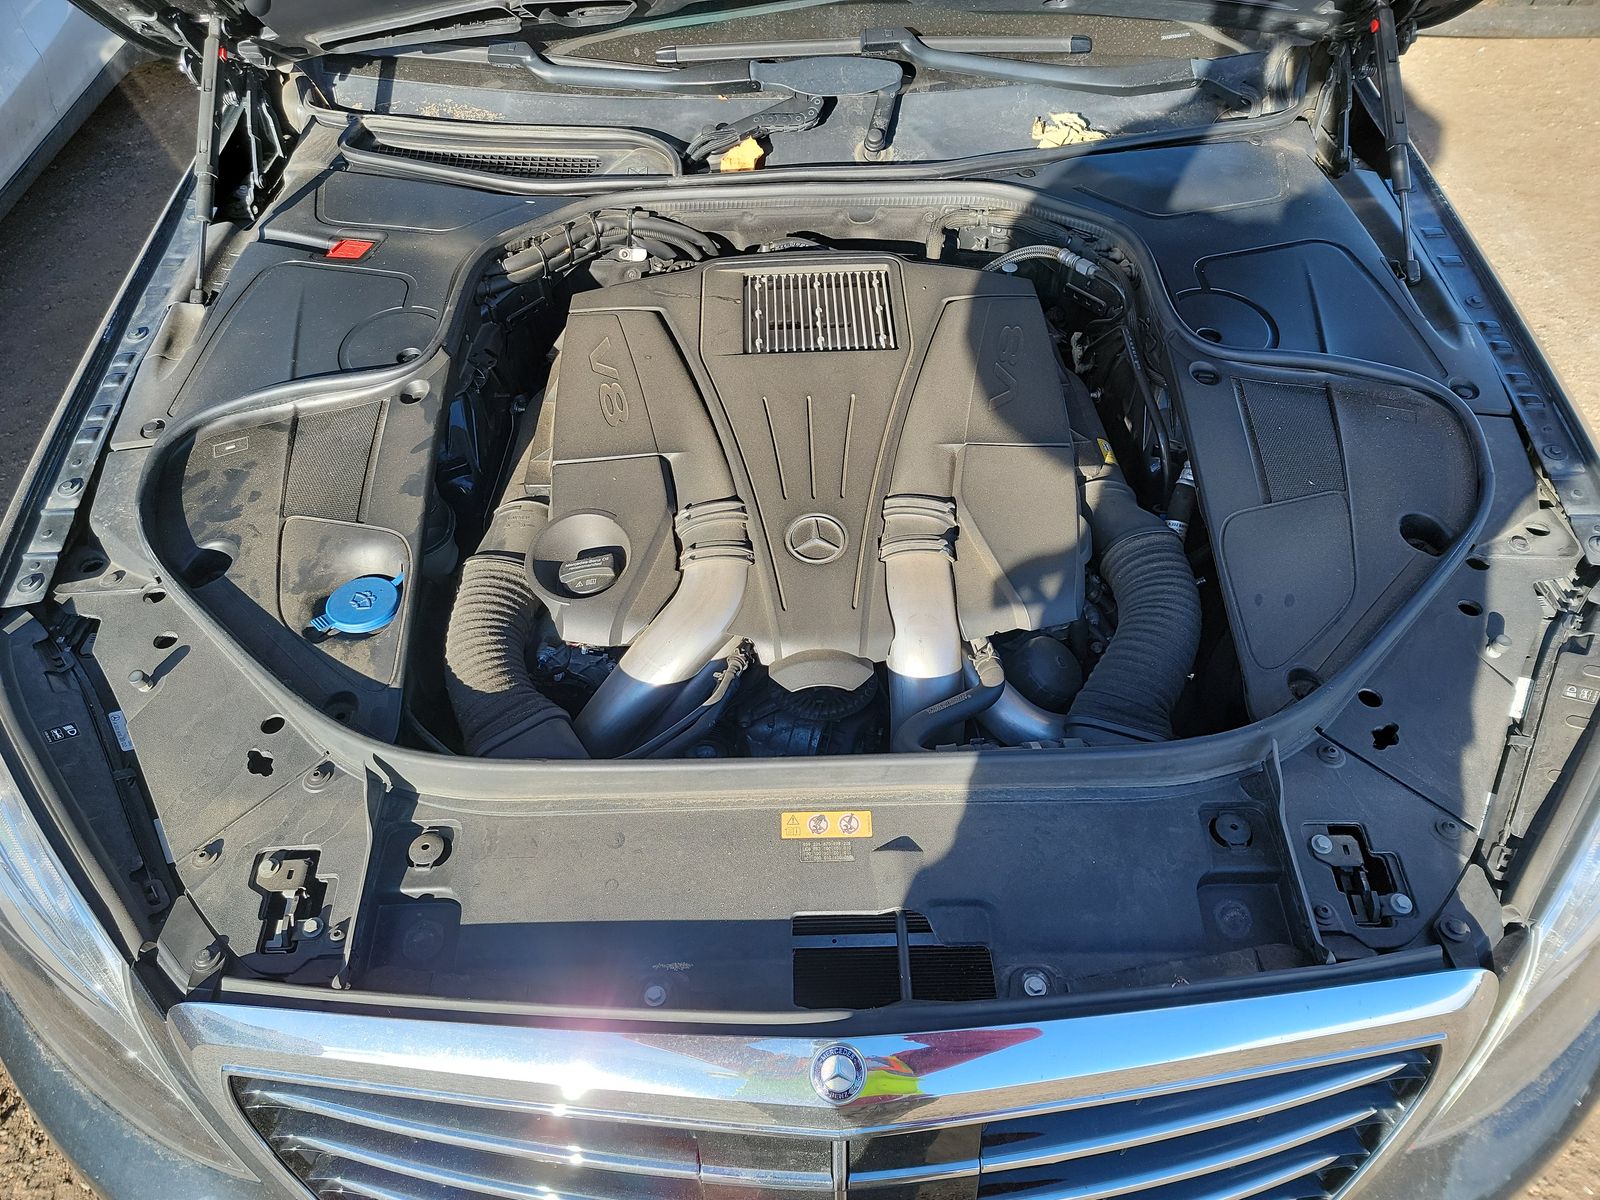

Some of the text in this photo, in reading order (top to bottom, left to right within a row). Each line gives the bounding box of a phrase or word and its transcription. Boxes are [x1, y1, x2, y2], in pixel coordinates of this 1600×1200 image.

[588, 336, 629, 428] V8
[988, 325, 1024, 411] V8
[820, 1047, 856, 1061] MERCEDES
